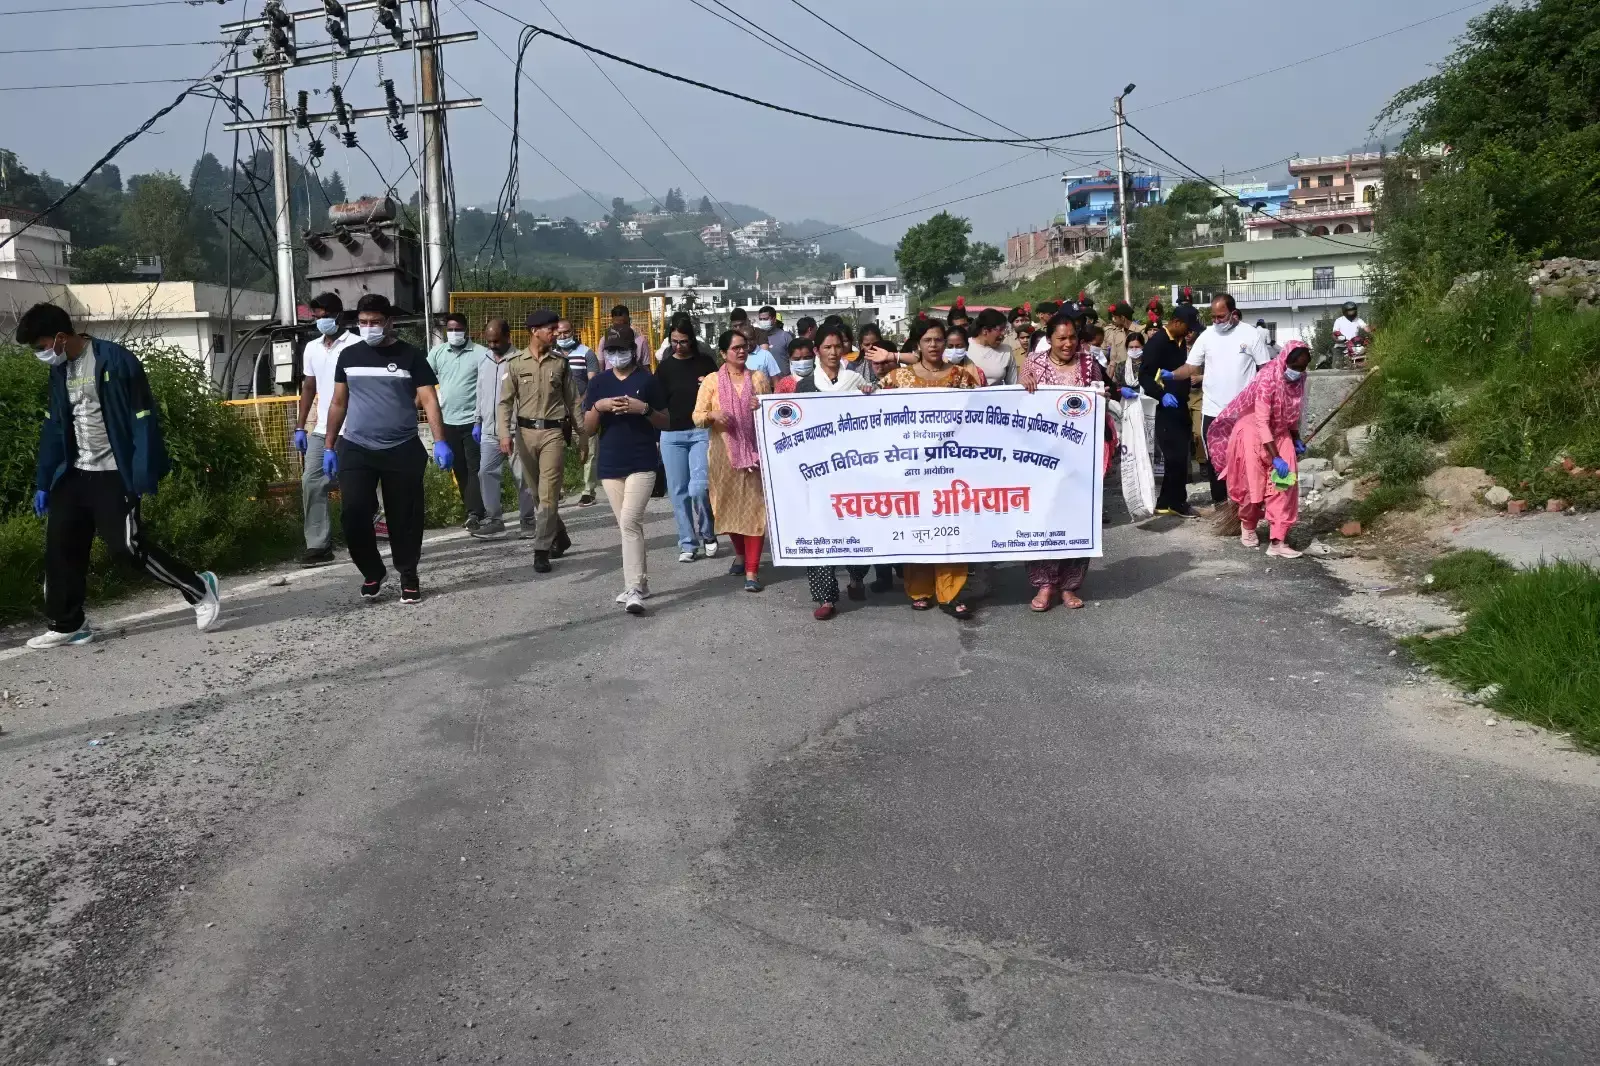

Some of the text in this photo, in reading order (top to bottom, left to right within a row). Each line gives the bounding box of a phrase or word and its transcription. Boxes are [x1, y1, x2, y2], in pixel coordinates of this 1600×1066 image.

[792, 430, 806, 447] उच्च
[804, 421, 837, 442] न्यायालय,
[837, 412, 869, 433] नैनीताल
[869, 408, 883, 429] एवं
[883, 406, 916, 427] माननीय
[918, 409, 963, 425] उत्तराखण्ड
[964, 409, 984, 425] राज्य
[985, 405, 1011, 426] विधिक
[1011, 409, 1028, 429] सेवा
[1027, 413, 1059, 438] प्राधिकरण,
[903, 430, 911, 440] के
[799, 440, 1061, 482] जिला विधिक सेवा प्राधिकरण, चम्पावत
[904, 466, 955, 477] द्वारा आयोजित
[830, 479, 1031, 520] स्वच्छता अभियान
[892, 530, 905, 541] 21
[1016, 529, 1031, 539] जिला
[991, 539, 1007, 549] जिला
[1007, 539, 1026, 548] विधिक
